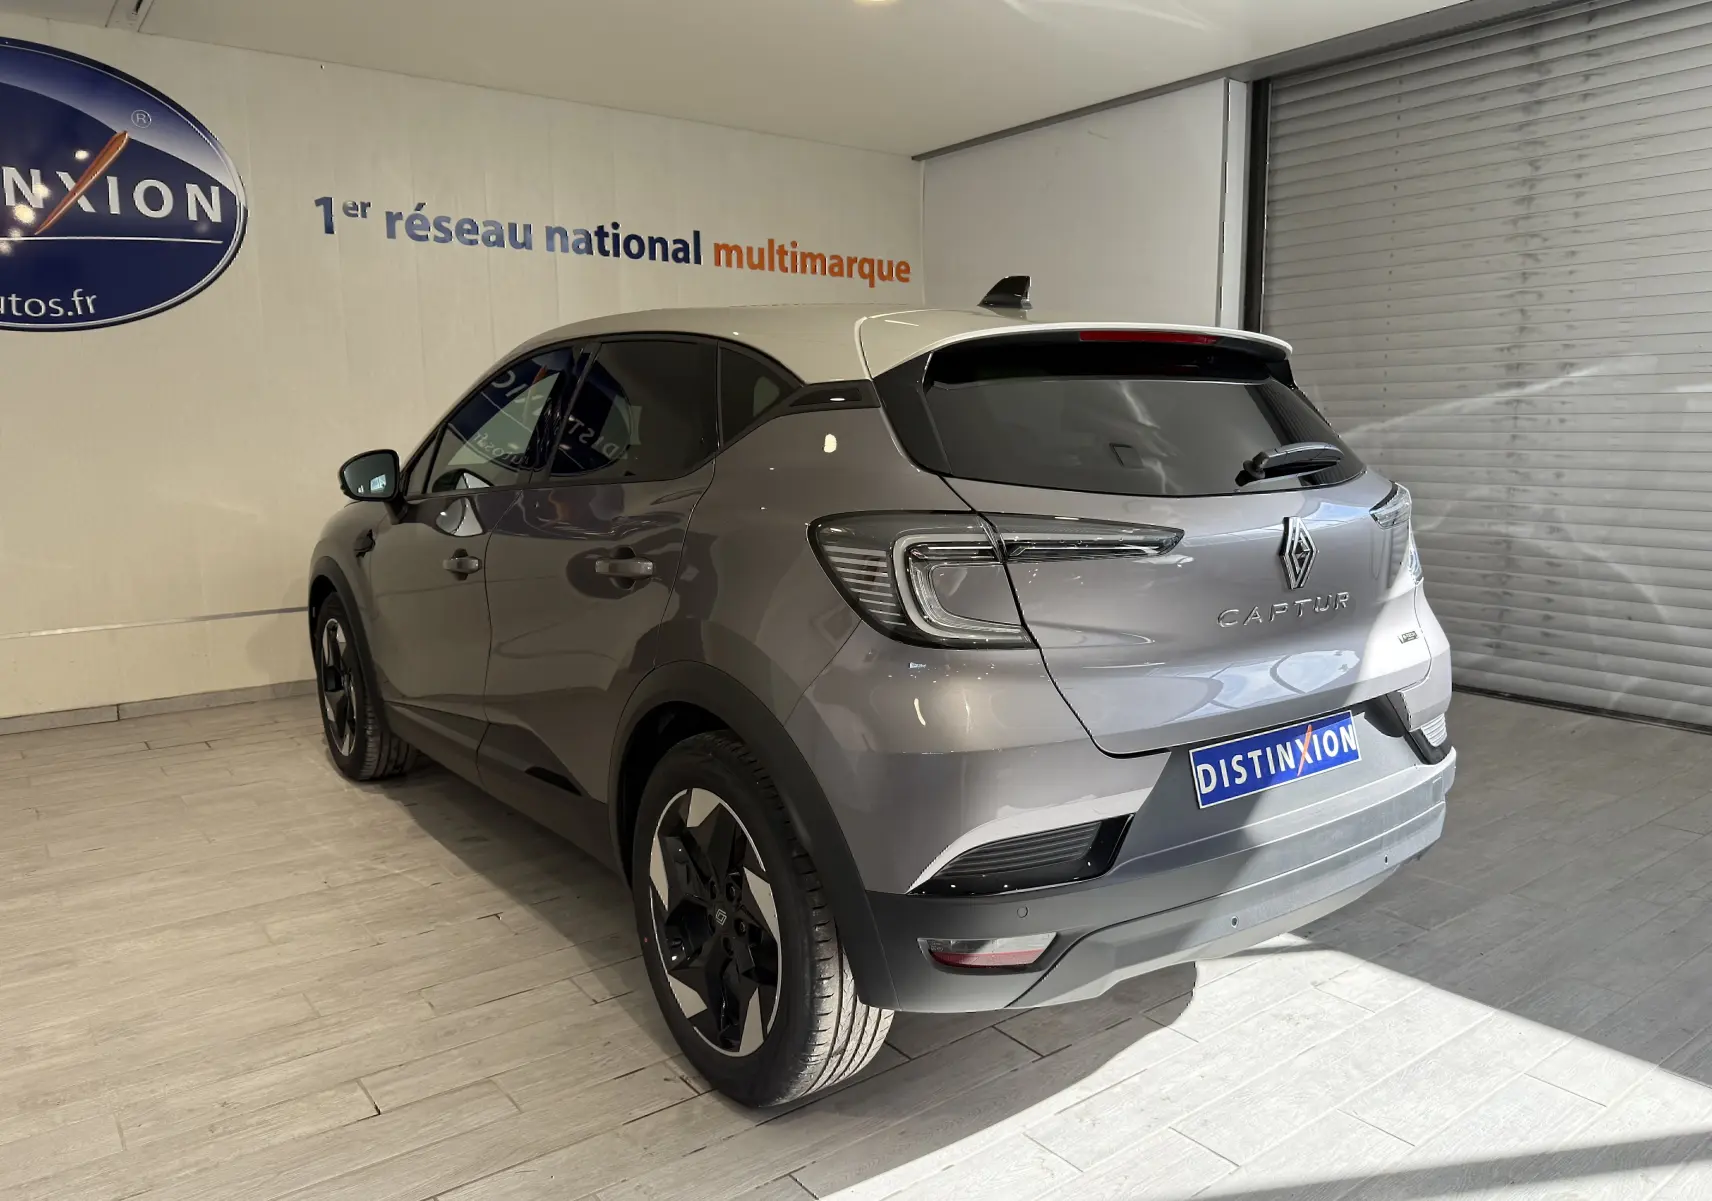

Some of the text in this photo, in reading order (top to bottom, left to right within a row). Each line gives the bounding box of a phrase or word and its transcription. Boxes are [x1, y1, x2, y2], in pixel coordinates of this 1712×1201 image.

[314, 196, 911, 288] 1er réseau national multimarque
[1217, 591, 1350, 628] CAPTUR
[1196, 724, 1357, 795] DISTINXION
